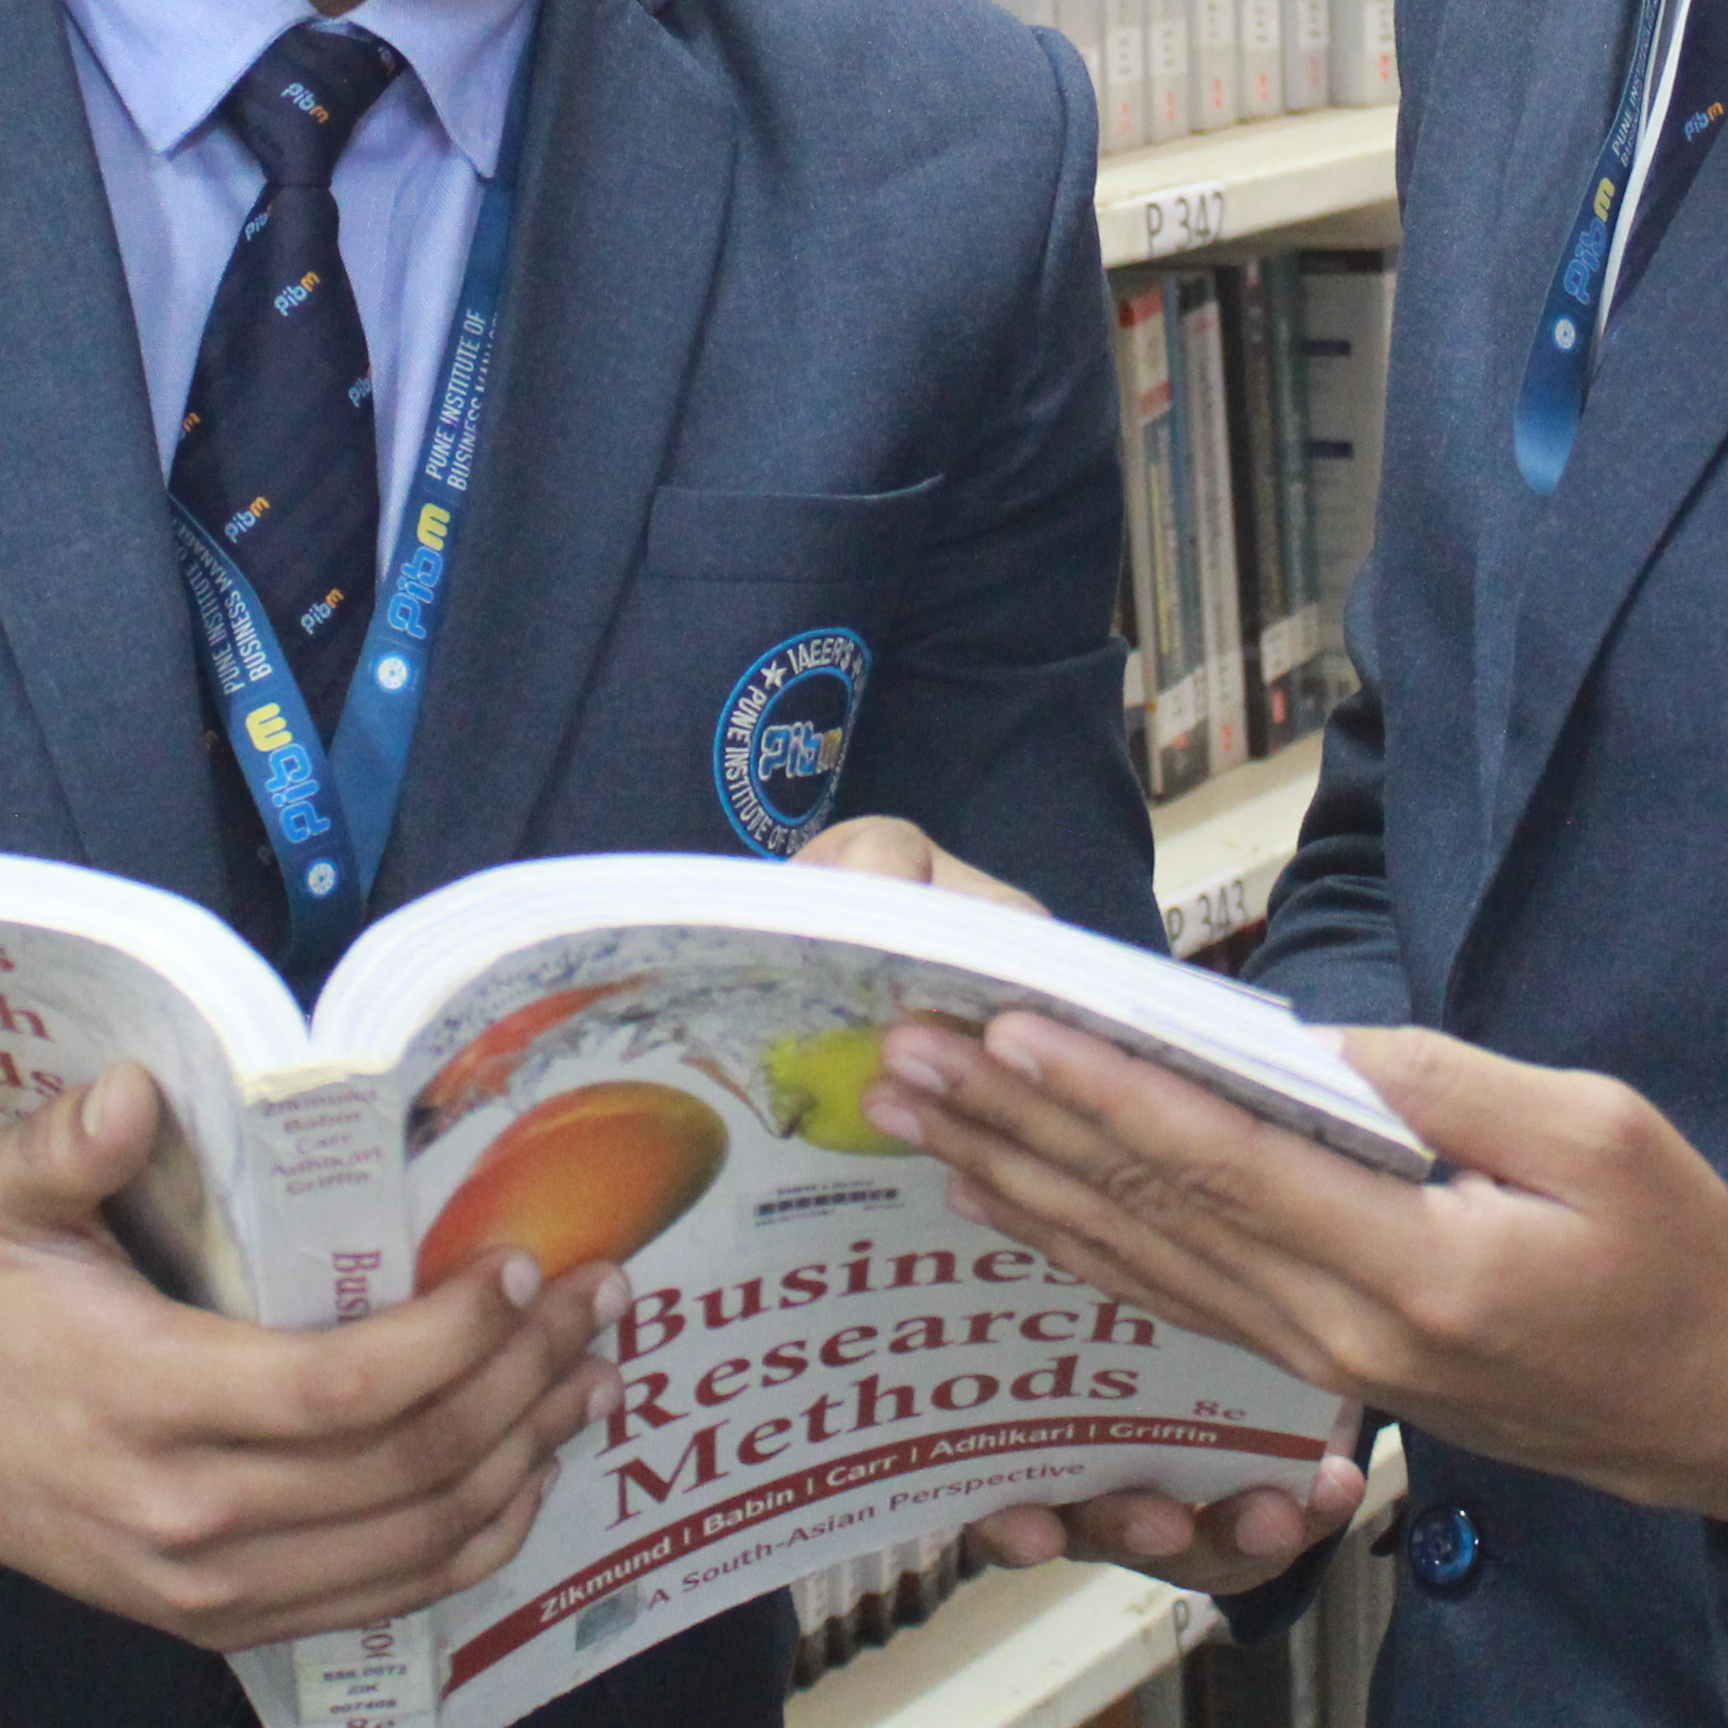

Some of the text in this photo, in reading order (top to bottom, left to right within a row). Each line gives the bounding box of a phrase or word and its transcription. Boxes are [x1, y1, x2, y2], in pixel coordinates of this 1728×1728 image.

[1145, 191, 1228, 251] P 342
[425, 426, 455, 481] PUNE
[440, 335, 481, 426] INSTITUTE
[465, 308, 486, 335] OF
[212, 643, 245, 696] PUNE
[224, 590, 273, 683] BUSINESS
[725, 685, 774, 840] PUNE INSTITUTE
[1196, 879, 1247, 943] 343
[616, 1239, 1086, 1368] Busines
[595, 1299, 1161, 1457] Research
[604, 1354, 1141, 1531] Methods
[1191, 1398, 1248, 1422] 8e
[536, 1422, 1219, 1621] Zikmund Babin Carr Adhikari Griffin
[647, 1461, 1086, 1610] A South-Asian Perspective
